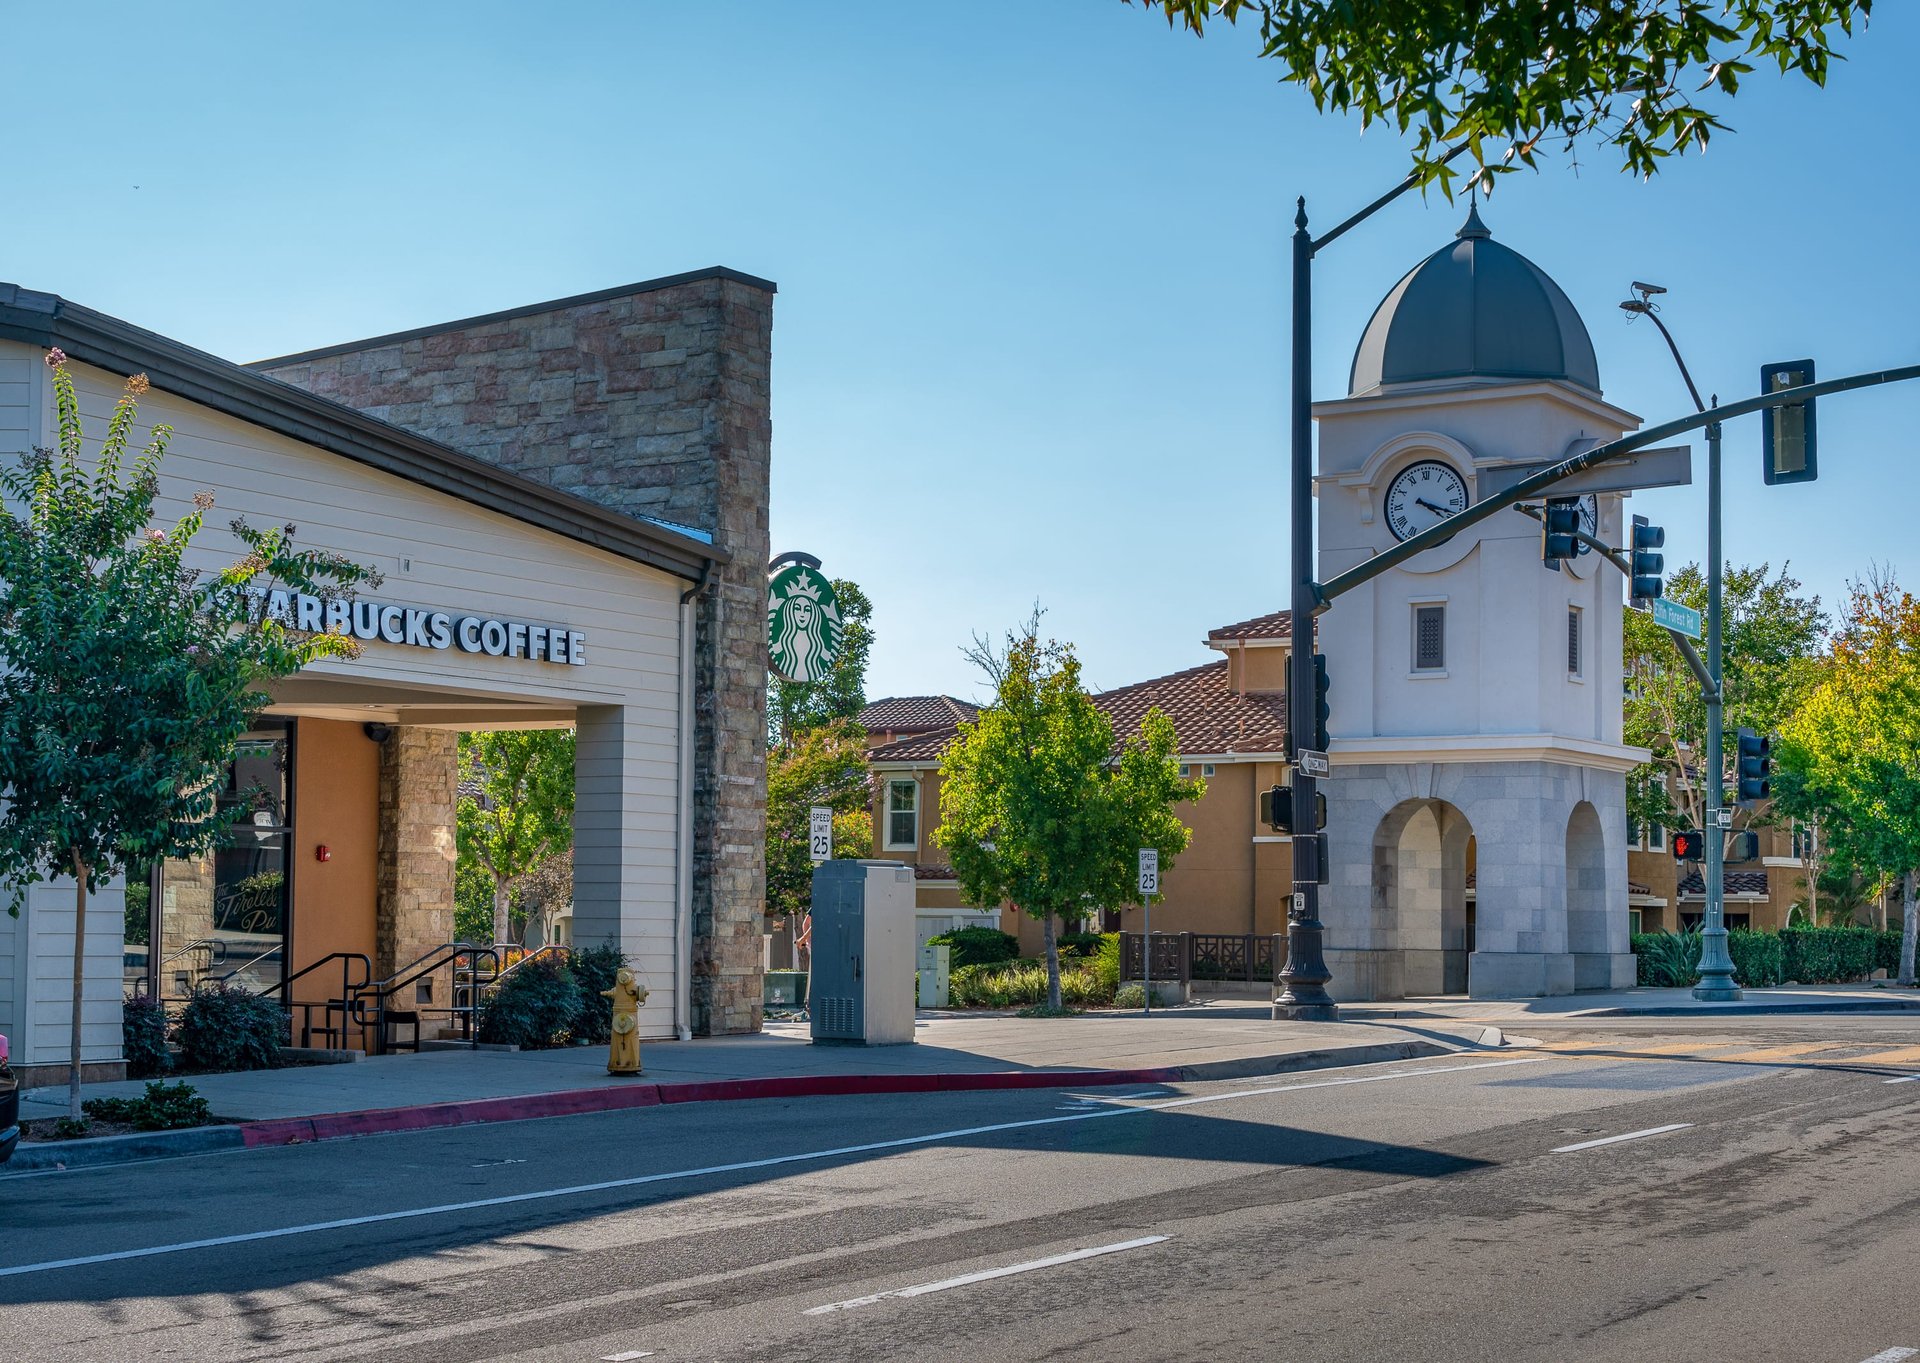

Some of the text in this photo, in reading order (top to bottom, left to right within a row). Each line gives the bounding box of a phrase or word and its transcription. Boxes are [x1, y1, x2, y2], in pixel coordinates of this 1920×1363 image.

[454, 616, 587, 666] COFFEE
[812, 813, 830, 822] SPEED
[813, 824, 828, 833] LIMIT
[813, 835, 828, 855] 25
[1141, 853, 1156, 861] SPEED
[1142, 873, 1155, 889] 25
